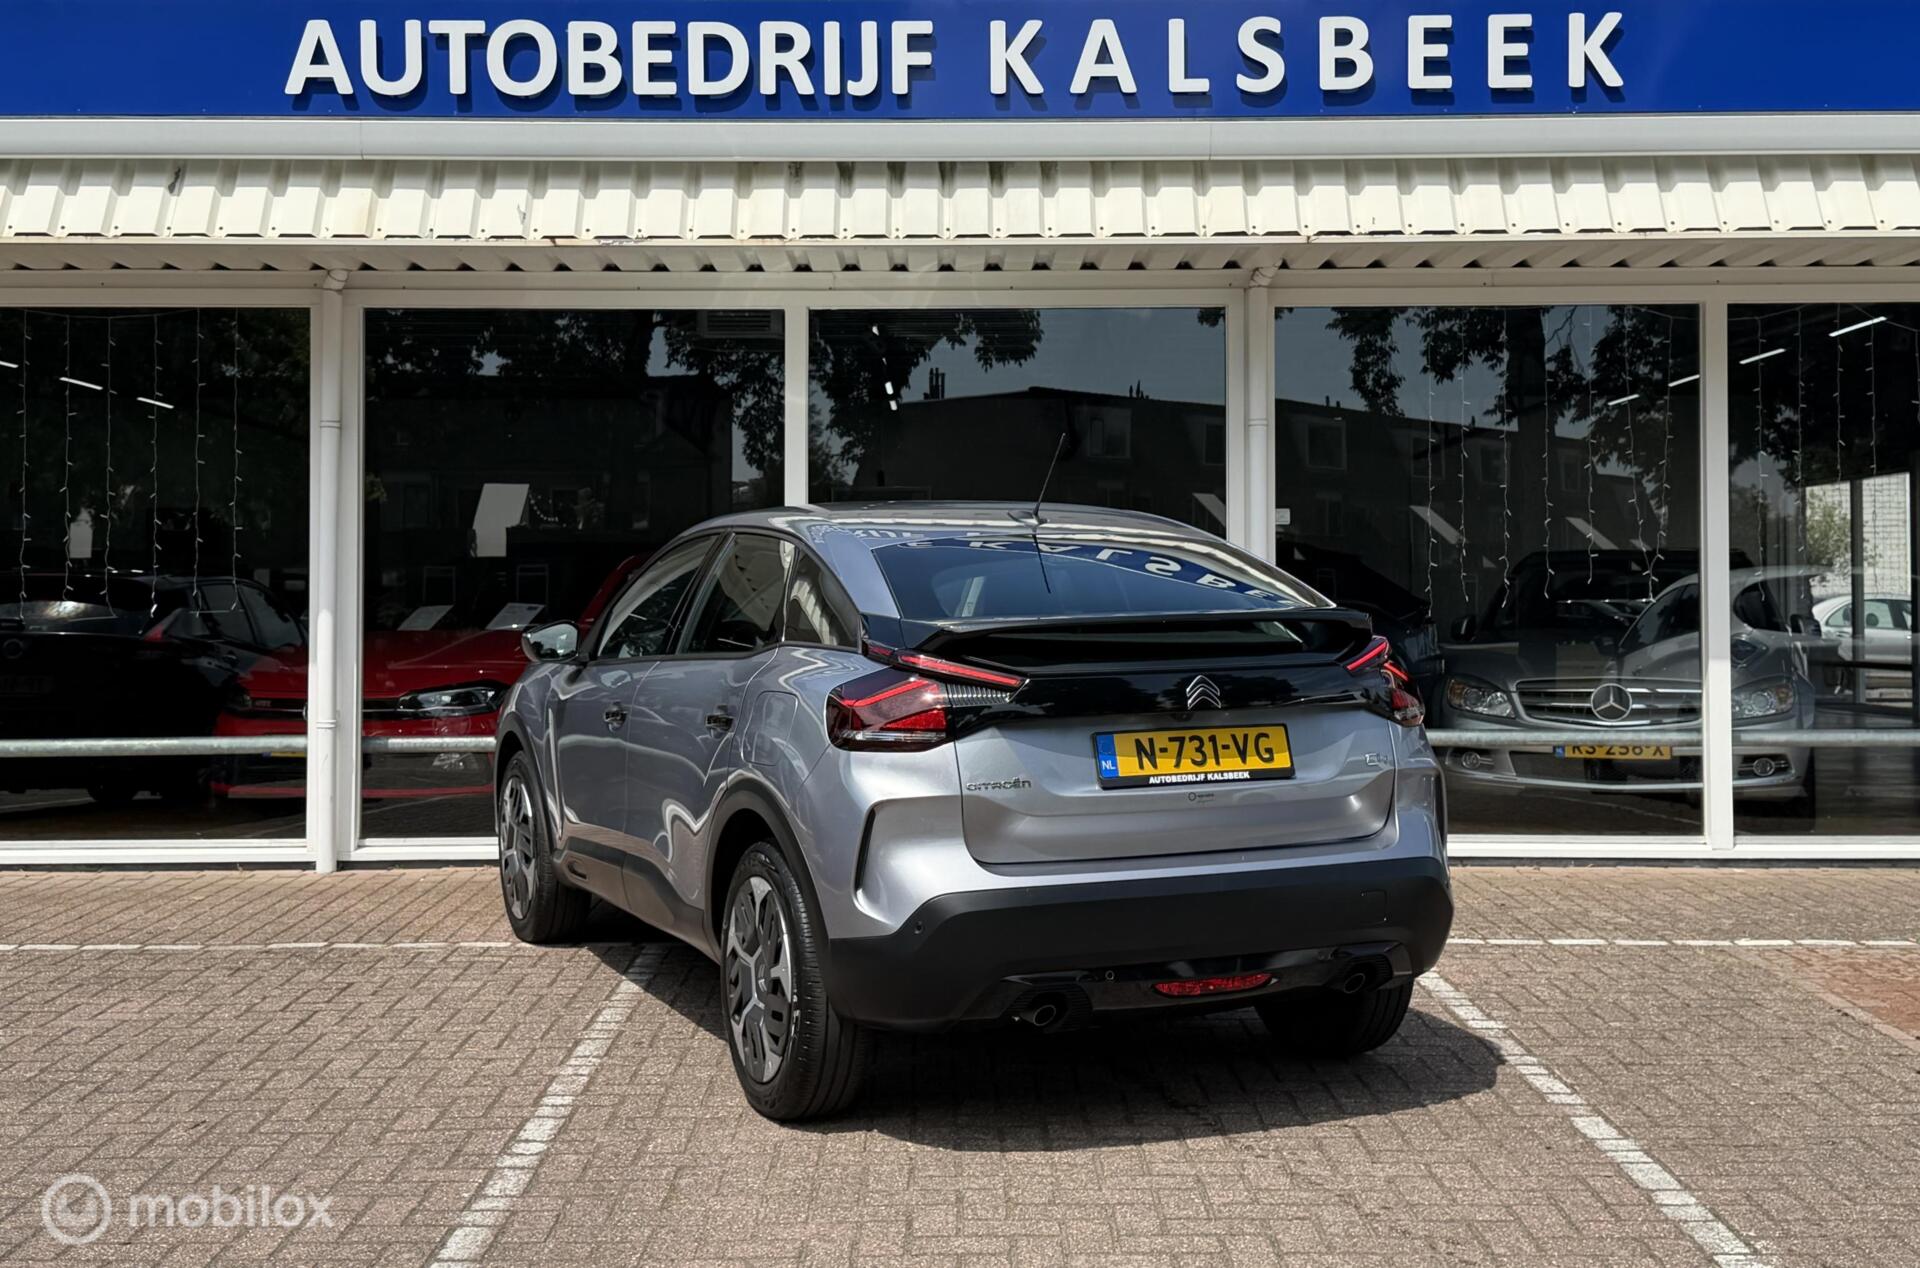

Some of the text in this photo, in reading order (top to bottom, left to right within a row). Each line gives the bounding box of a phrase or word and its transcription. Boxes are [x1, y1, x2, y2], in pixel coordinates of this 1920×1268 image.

[284, 12, 1624, 98] AUTOBEDRIJF KALSBEEK
[1134, 732, 1275, 770] N-731-VG
[1102, 760, 1116, 770] NL
[1149, 771, 1250, 784] AUTOBEDRIJF KALSBEEK
